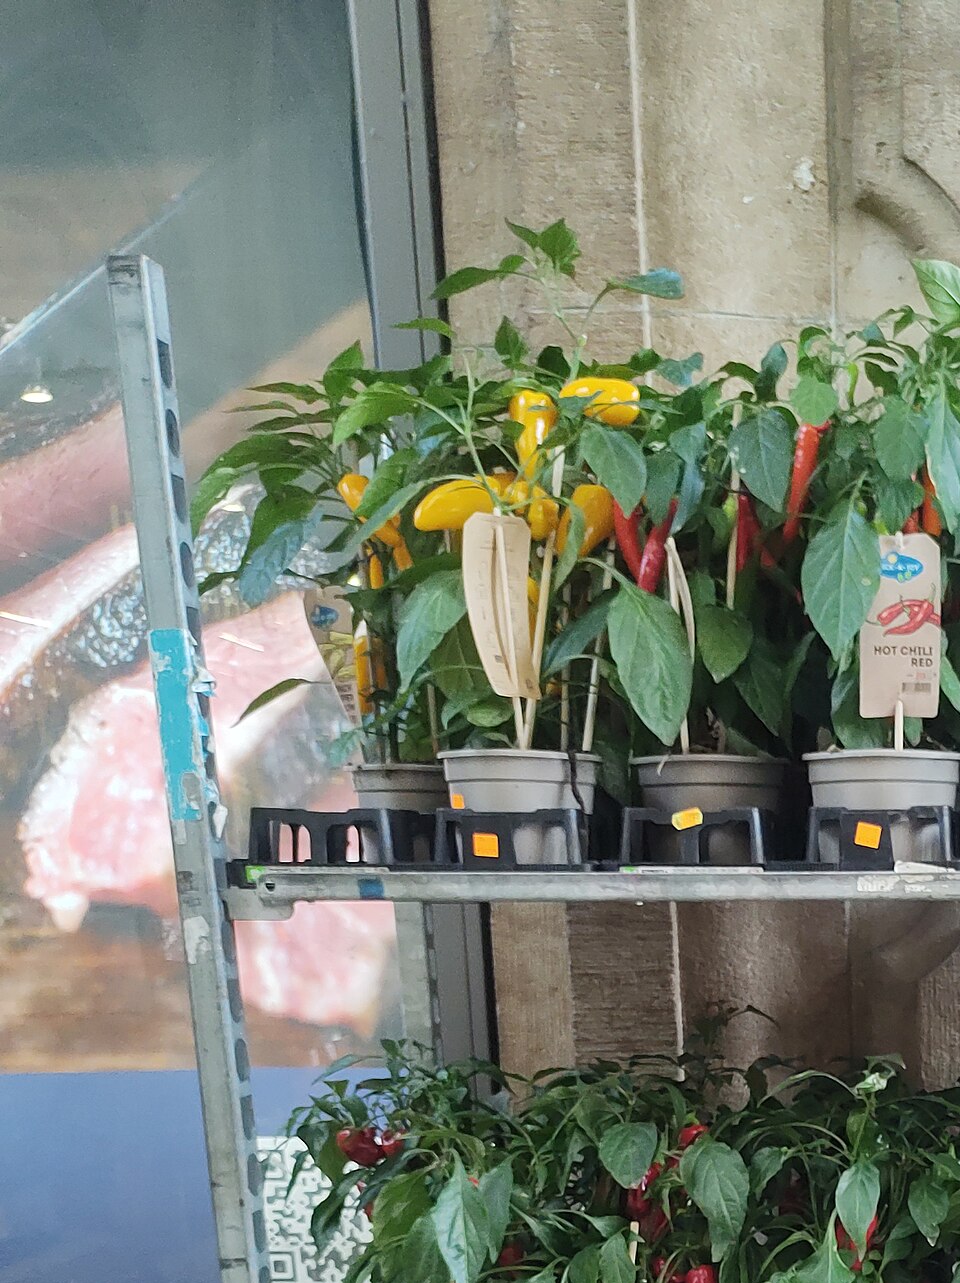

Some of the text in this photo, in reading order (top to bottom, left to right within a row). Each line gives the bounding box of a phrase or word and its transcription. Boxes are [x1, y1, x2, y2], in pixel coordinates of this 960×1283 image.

[873, 645, 933, 656] HOT CHILI
[911, 657, 933, 668] RED
